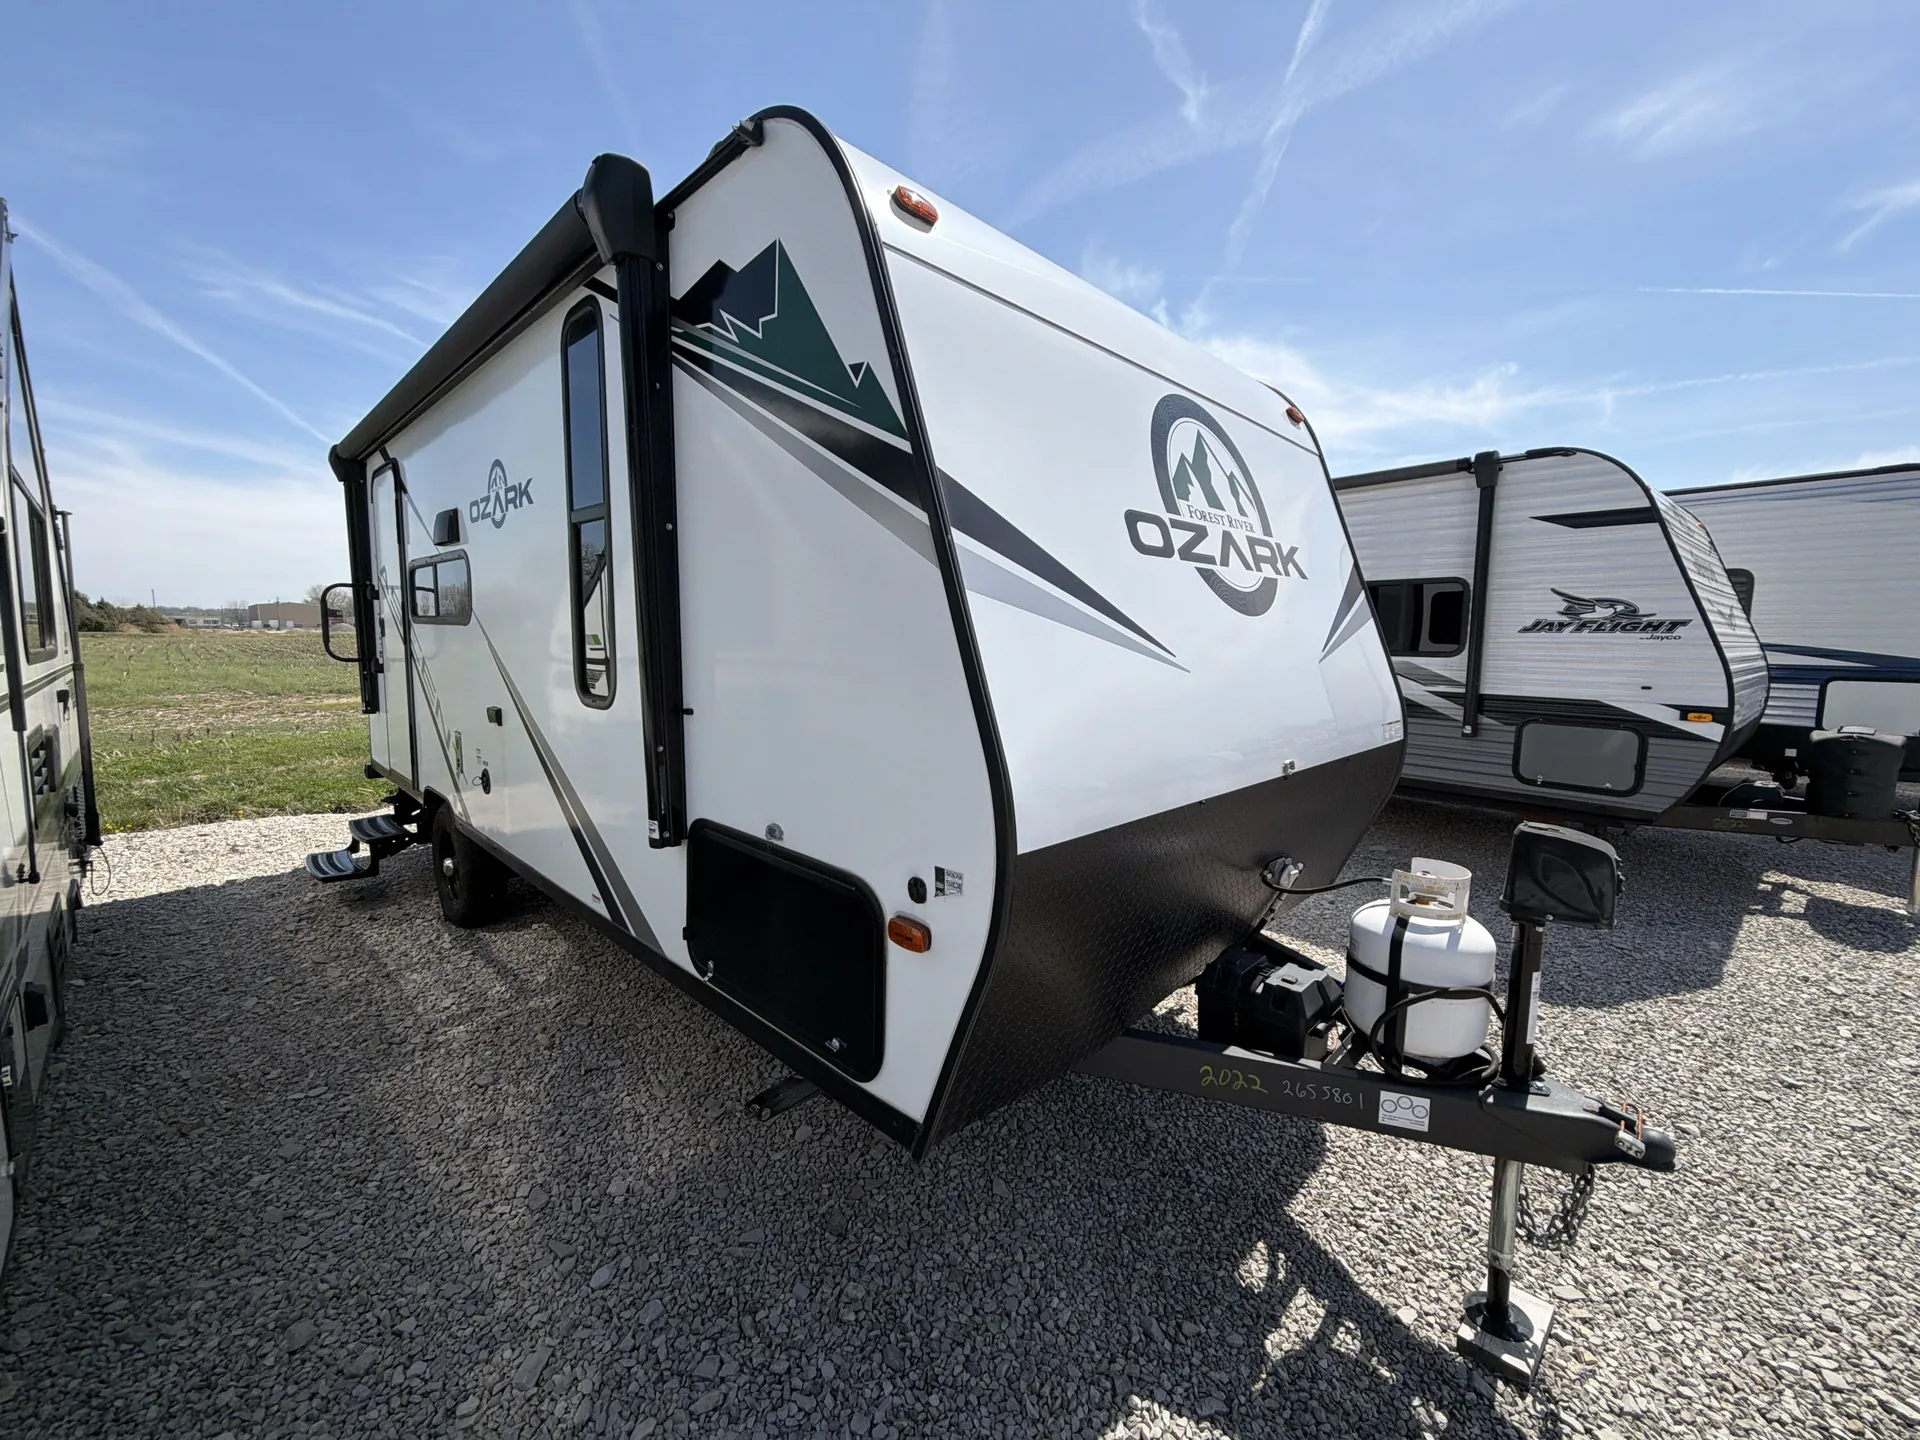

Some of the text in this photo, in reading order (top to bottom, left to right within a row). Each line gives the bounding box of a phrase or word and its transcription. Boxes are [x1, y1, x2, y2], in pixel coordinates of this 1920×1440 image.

[469, 477, 534, 523] OZARK
[1186, 504, 1256, 533] FOREST RIVER
[1124, 508, 1309, 580] OZARK
[1517, 618, 1693, 634] JAY FLIGHT
[1646, 633, 1682, 641] Jayco
[1200, 1065, 1269, 1094] 2022
